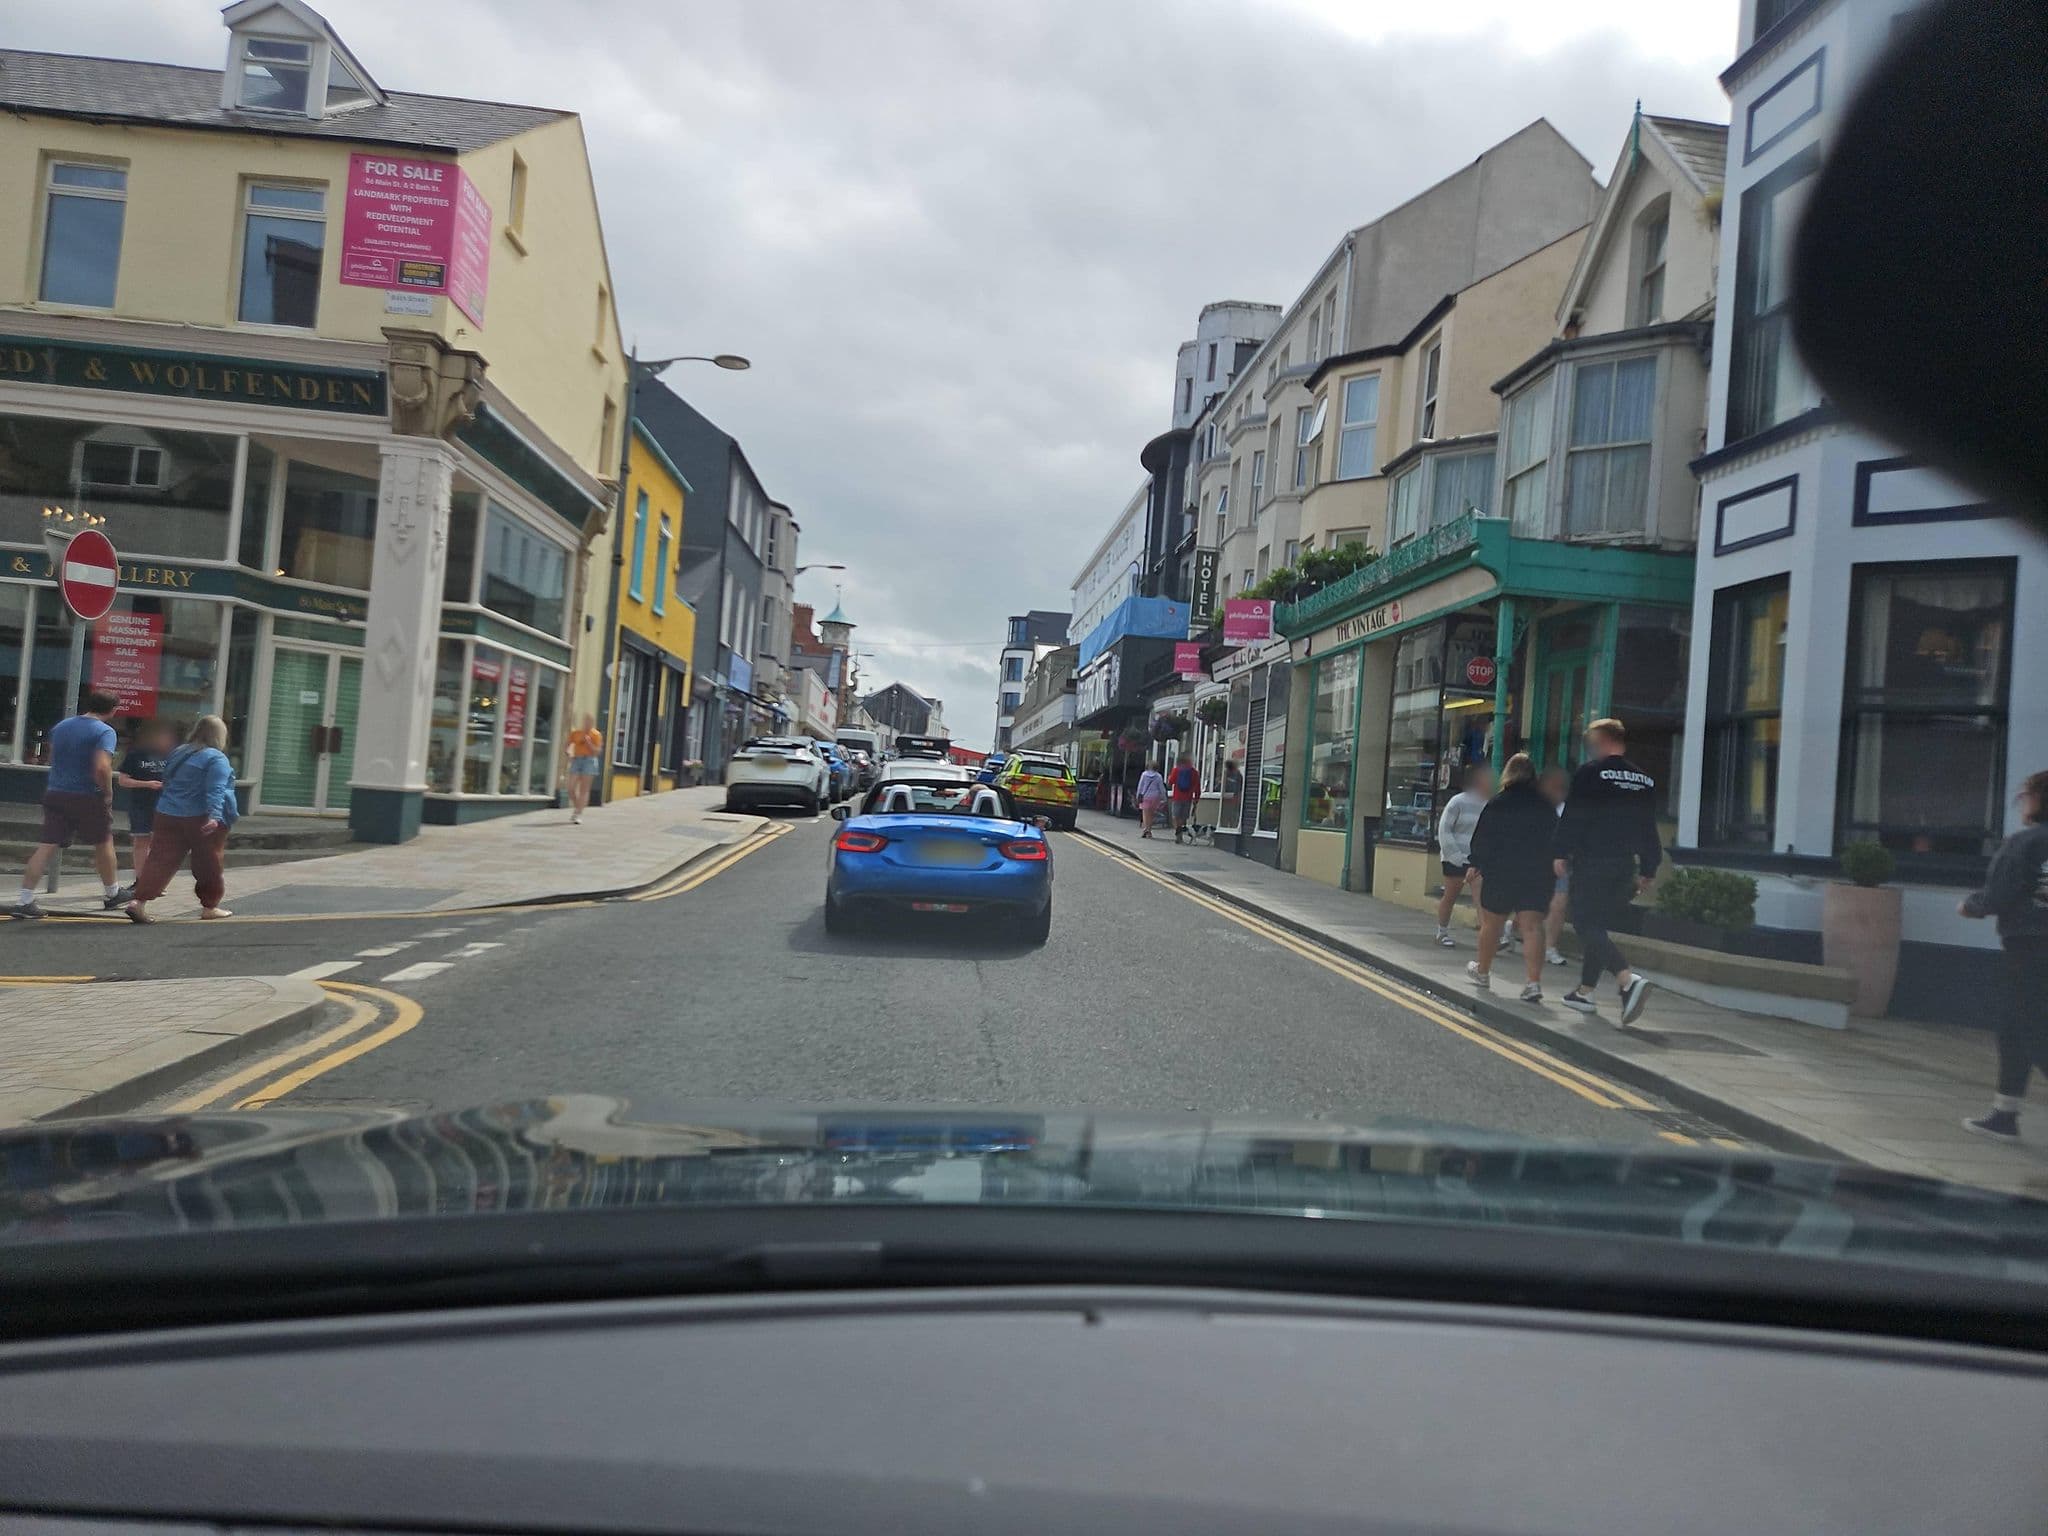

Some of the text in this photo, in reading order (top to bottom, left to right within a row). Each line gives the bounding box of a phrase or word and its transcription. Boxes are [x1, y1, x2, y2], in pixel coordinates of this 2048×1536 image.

[365, 161, 442, 181] FOR SALE
[354, 189, 449, 207] LANDMARK PROPERTIES
[390, 203, 412, 213] WITH
[366, 211, 434, 227] REDEVELOPMENT
[377, 223, 421, 236] POTENTIAL
[83, 356, 109, 382] &
[129, 360, 372, 406] WOLFENDEN
[13, 556, 196, 588] & JLLERY
[1200, 555, 1212, 616] HOTEL
[108, 615, 151, 626] GENUINE
[1336, 623, 1350, 642] THE
[1353, 608, 1387, 636] VINTAGE
[108, 627, 150, 638] MASSIVE
[99, 635, 157, 648] RETIREMENT
[114, 647, 138, 657] SALE
[1469, 665, 1494, 676] STOP
